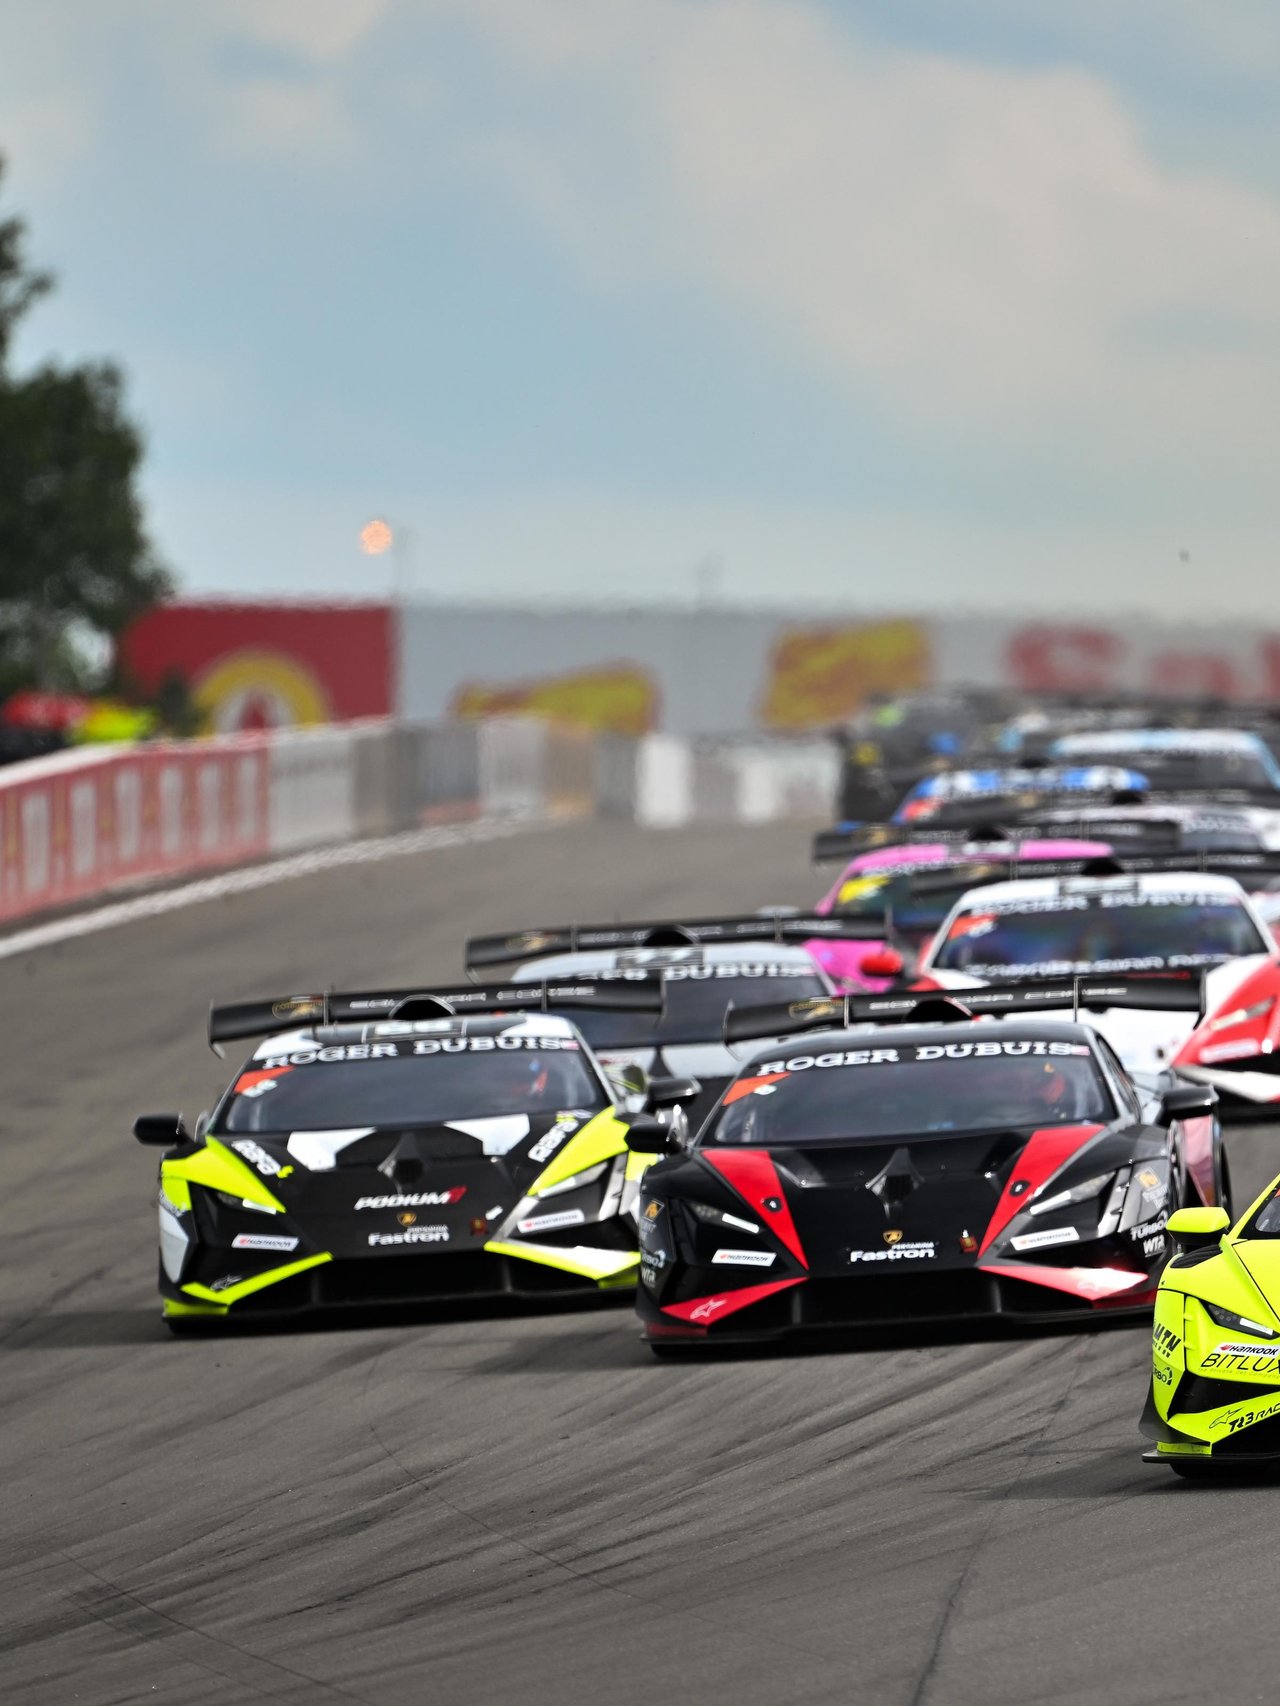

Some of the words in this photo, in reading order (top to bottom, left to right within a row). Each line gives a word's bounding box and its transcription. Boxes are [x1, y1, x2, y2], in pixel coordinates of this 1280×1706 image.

[263, 1043, 398, 1068] ROGER
[414, 1036, 560, 1055] DUBUIS
[756, 1049, 899, 1076] ROGER
[915, 1041, 1072, 1060] DUBUIS
[367, 1232, 450, 1247] Fastron
[850, 1249, 935, 1263] Fastron
